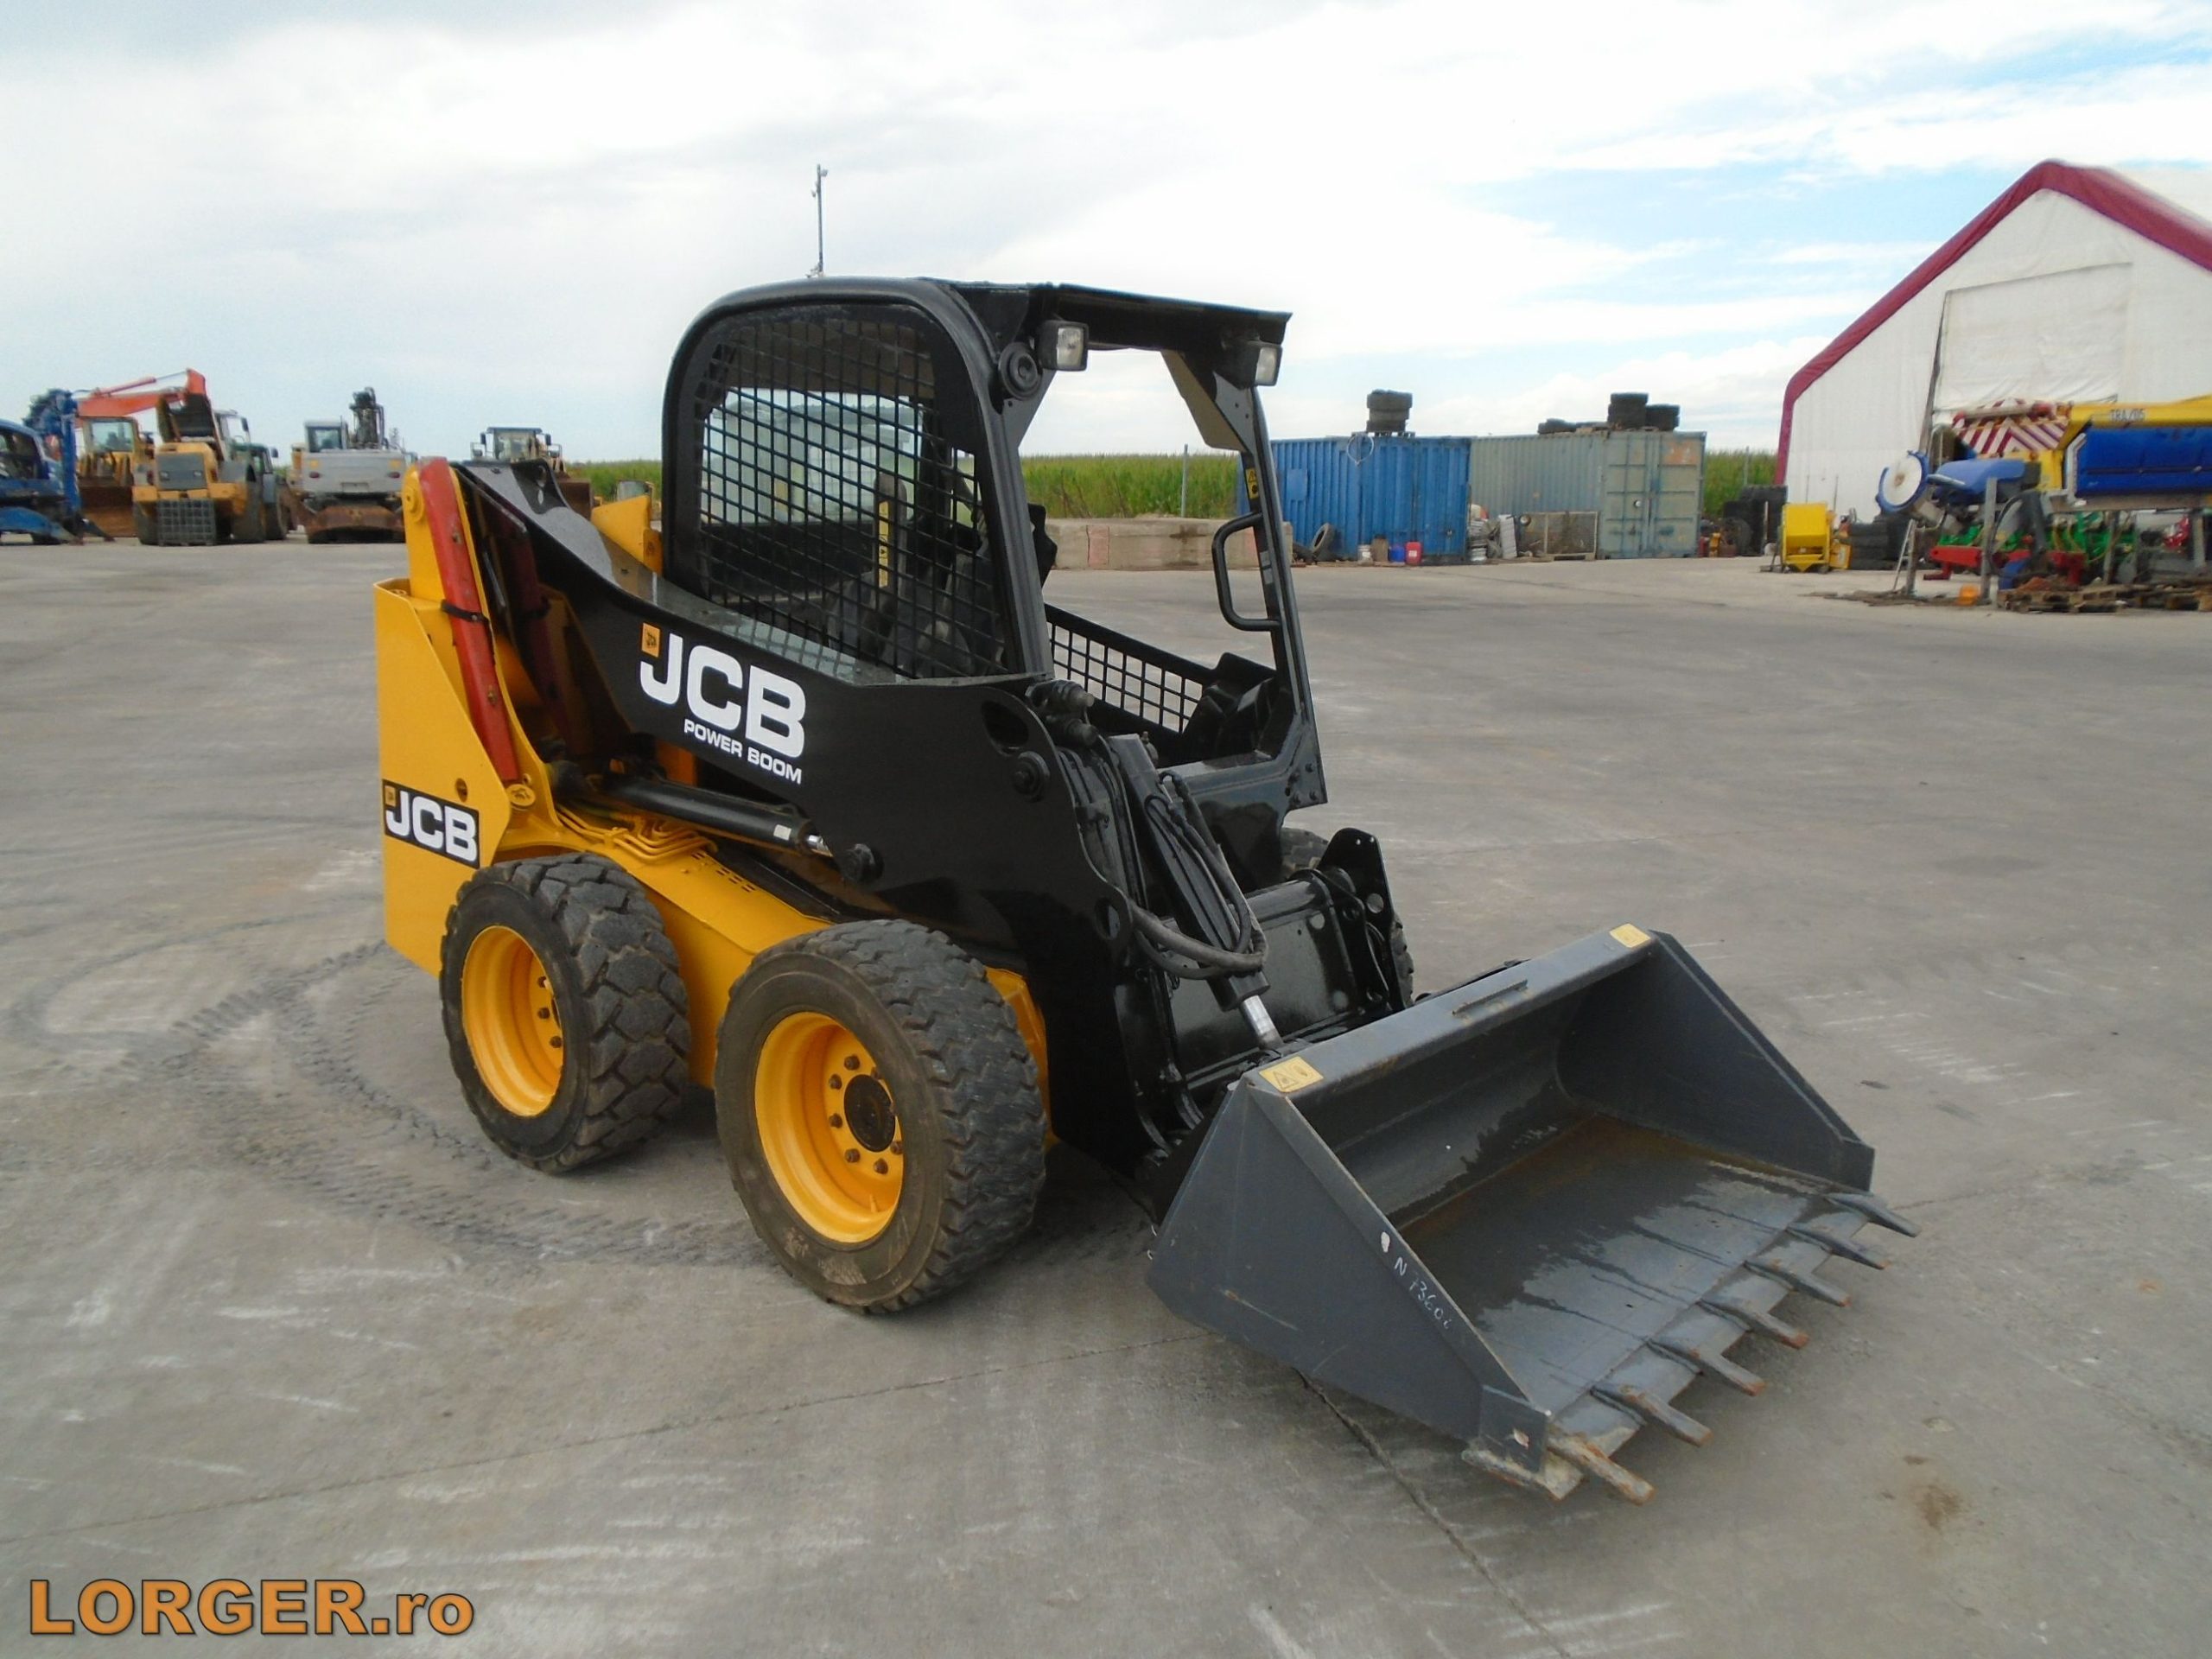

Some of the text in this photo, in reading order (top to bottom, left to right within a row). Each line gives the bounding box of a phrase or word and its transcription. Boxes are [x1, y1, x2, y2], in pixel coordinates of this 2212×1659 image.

[640, 632, 806, 758] JCB
[683, 718, 803, 785] POWER BOOM
[385, 790, 478, 861] JCB
